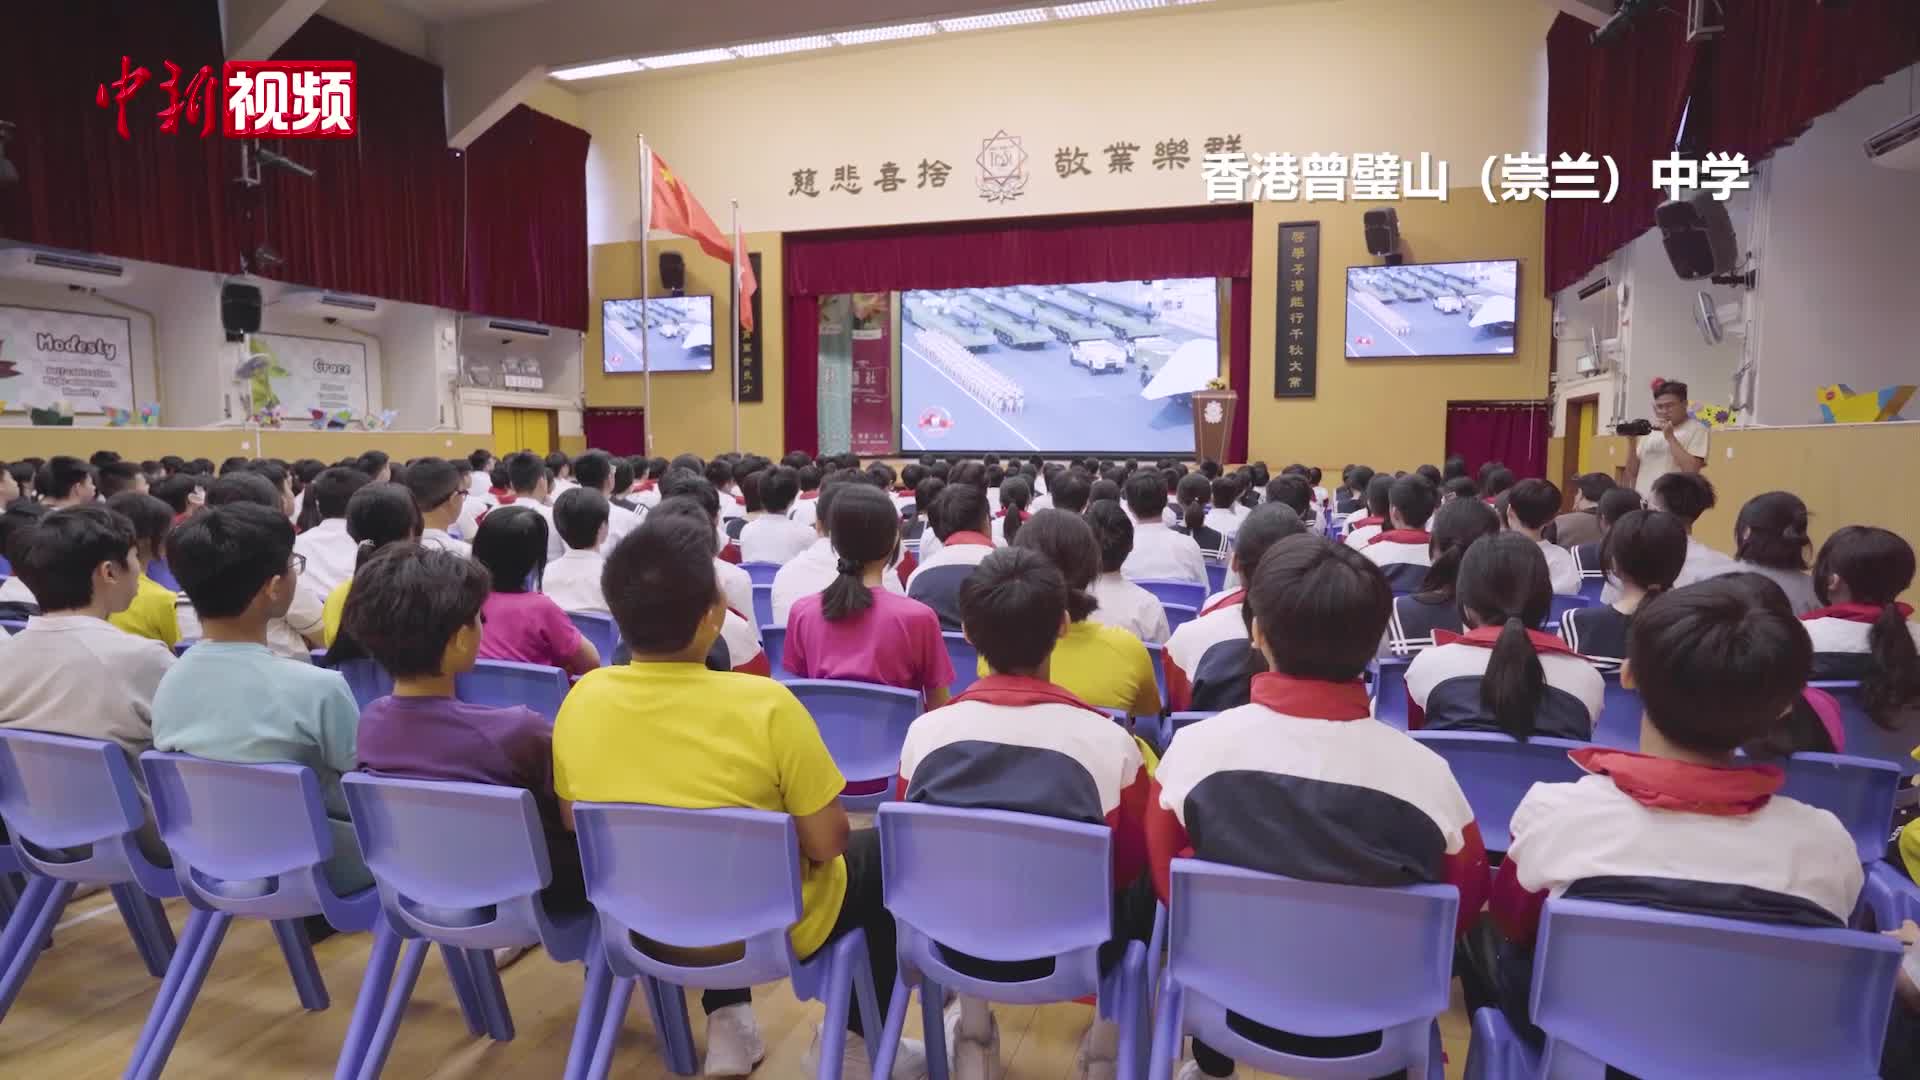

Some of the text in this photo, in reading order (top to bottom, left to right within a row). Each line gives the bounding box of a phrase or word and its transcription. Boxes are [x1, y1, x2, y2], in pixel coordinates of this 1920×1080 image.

[788, 158, 952, 198] 慈悲喜捨
[36, 332, 117, 361] Modesty
